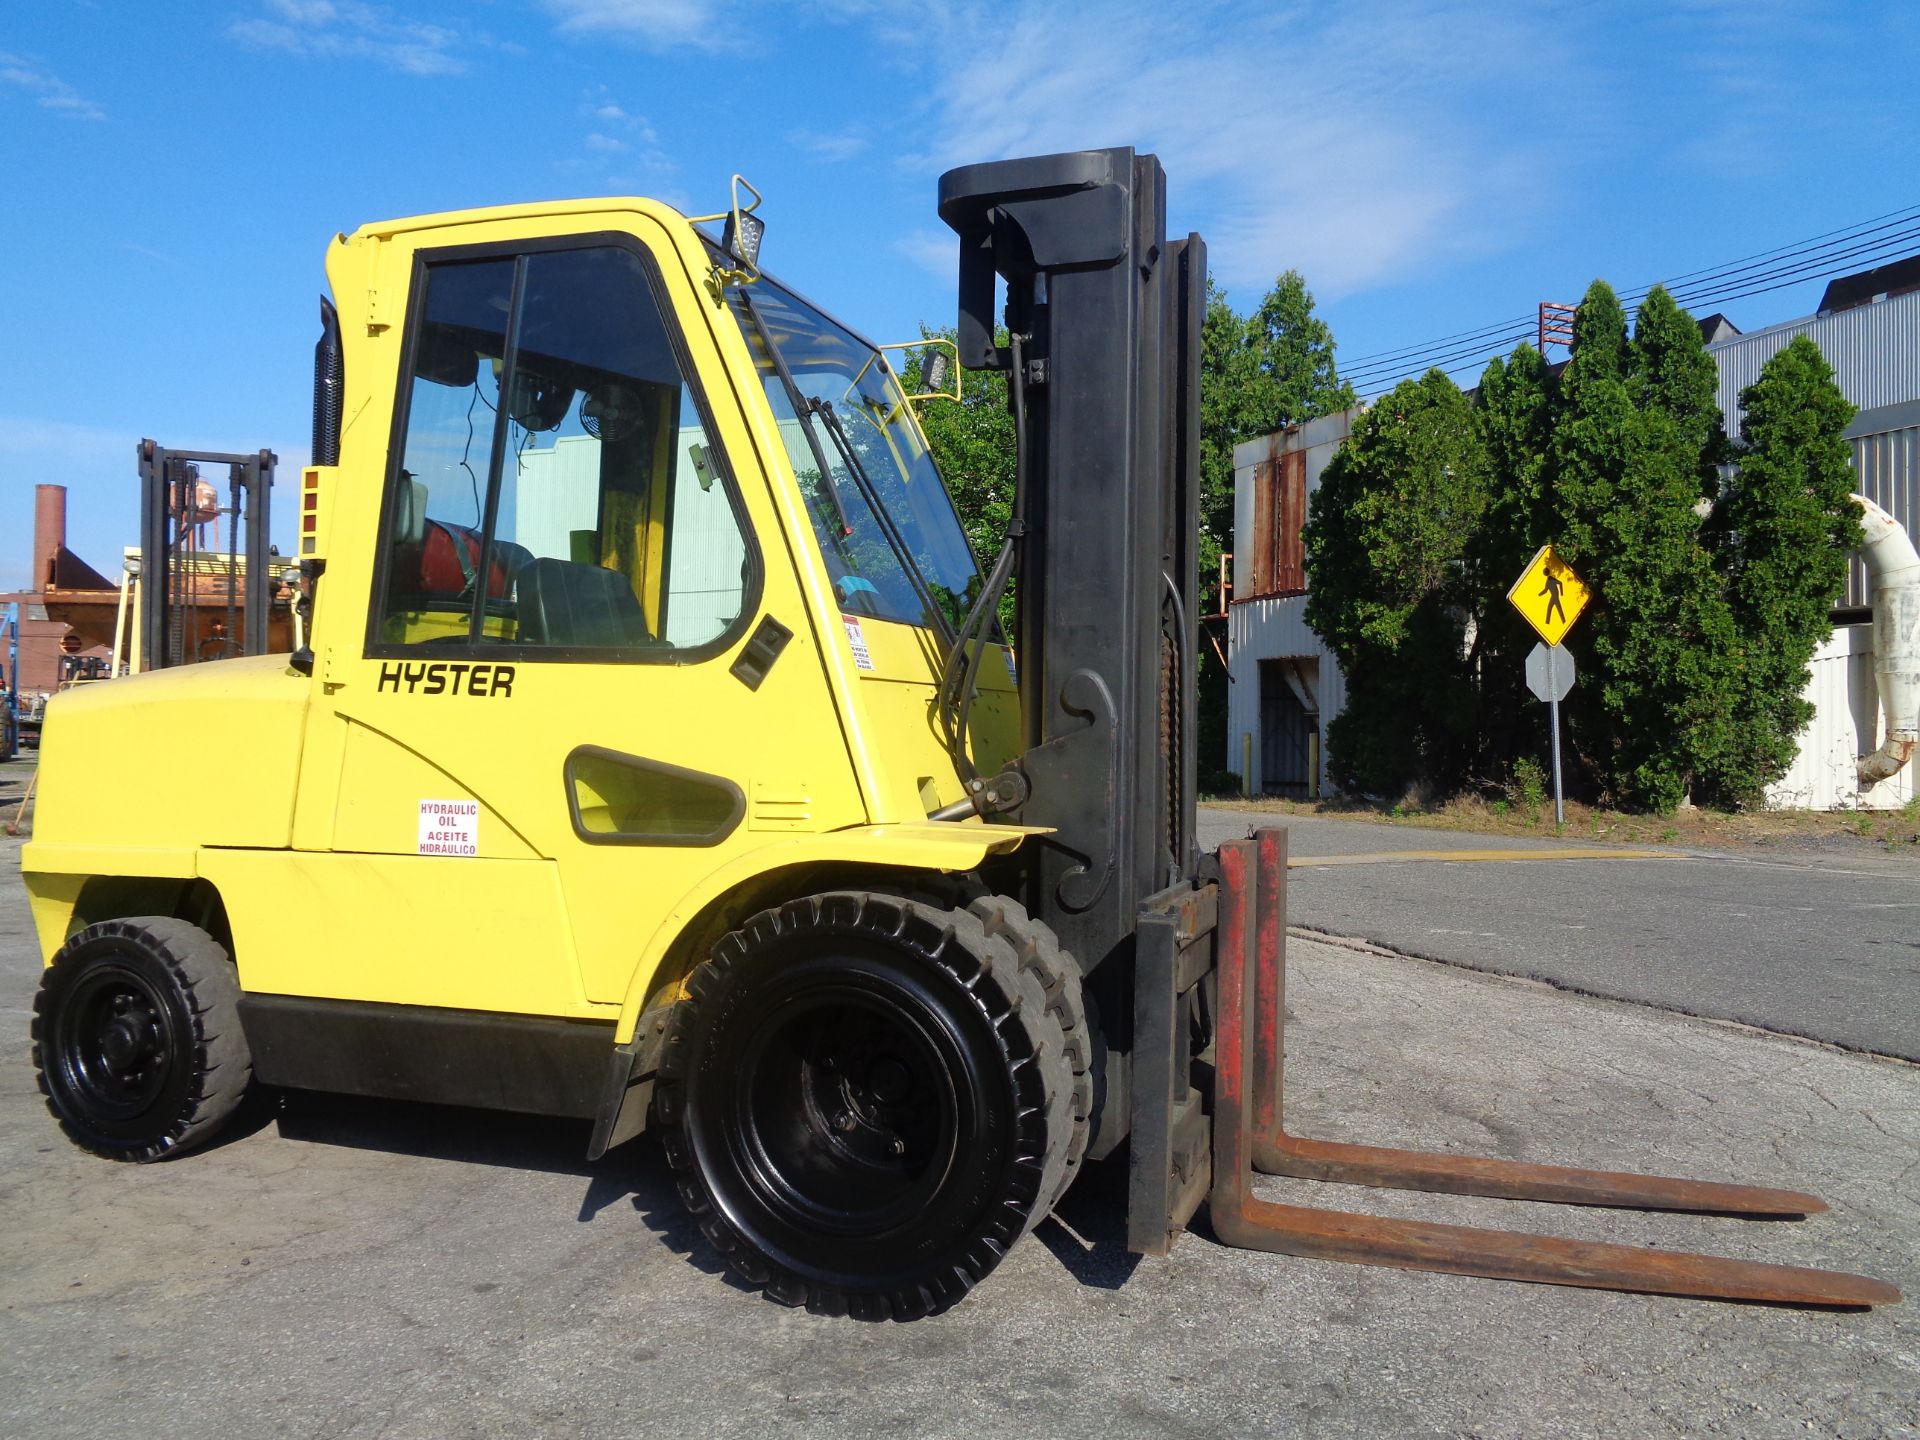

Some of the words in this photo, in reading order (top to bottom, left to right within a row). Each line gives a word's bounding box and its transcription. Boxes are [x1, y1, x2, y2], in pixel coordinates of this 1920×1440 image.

[377, 662, 516, 697] HYSTER
[420, 803, 476, 815] HYDRAULIC
[438, 815, 457, 826] OIL
[427, 831, 468, 842] ACEITE
